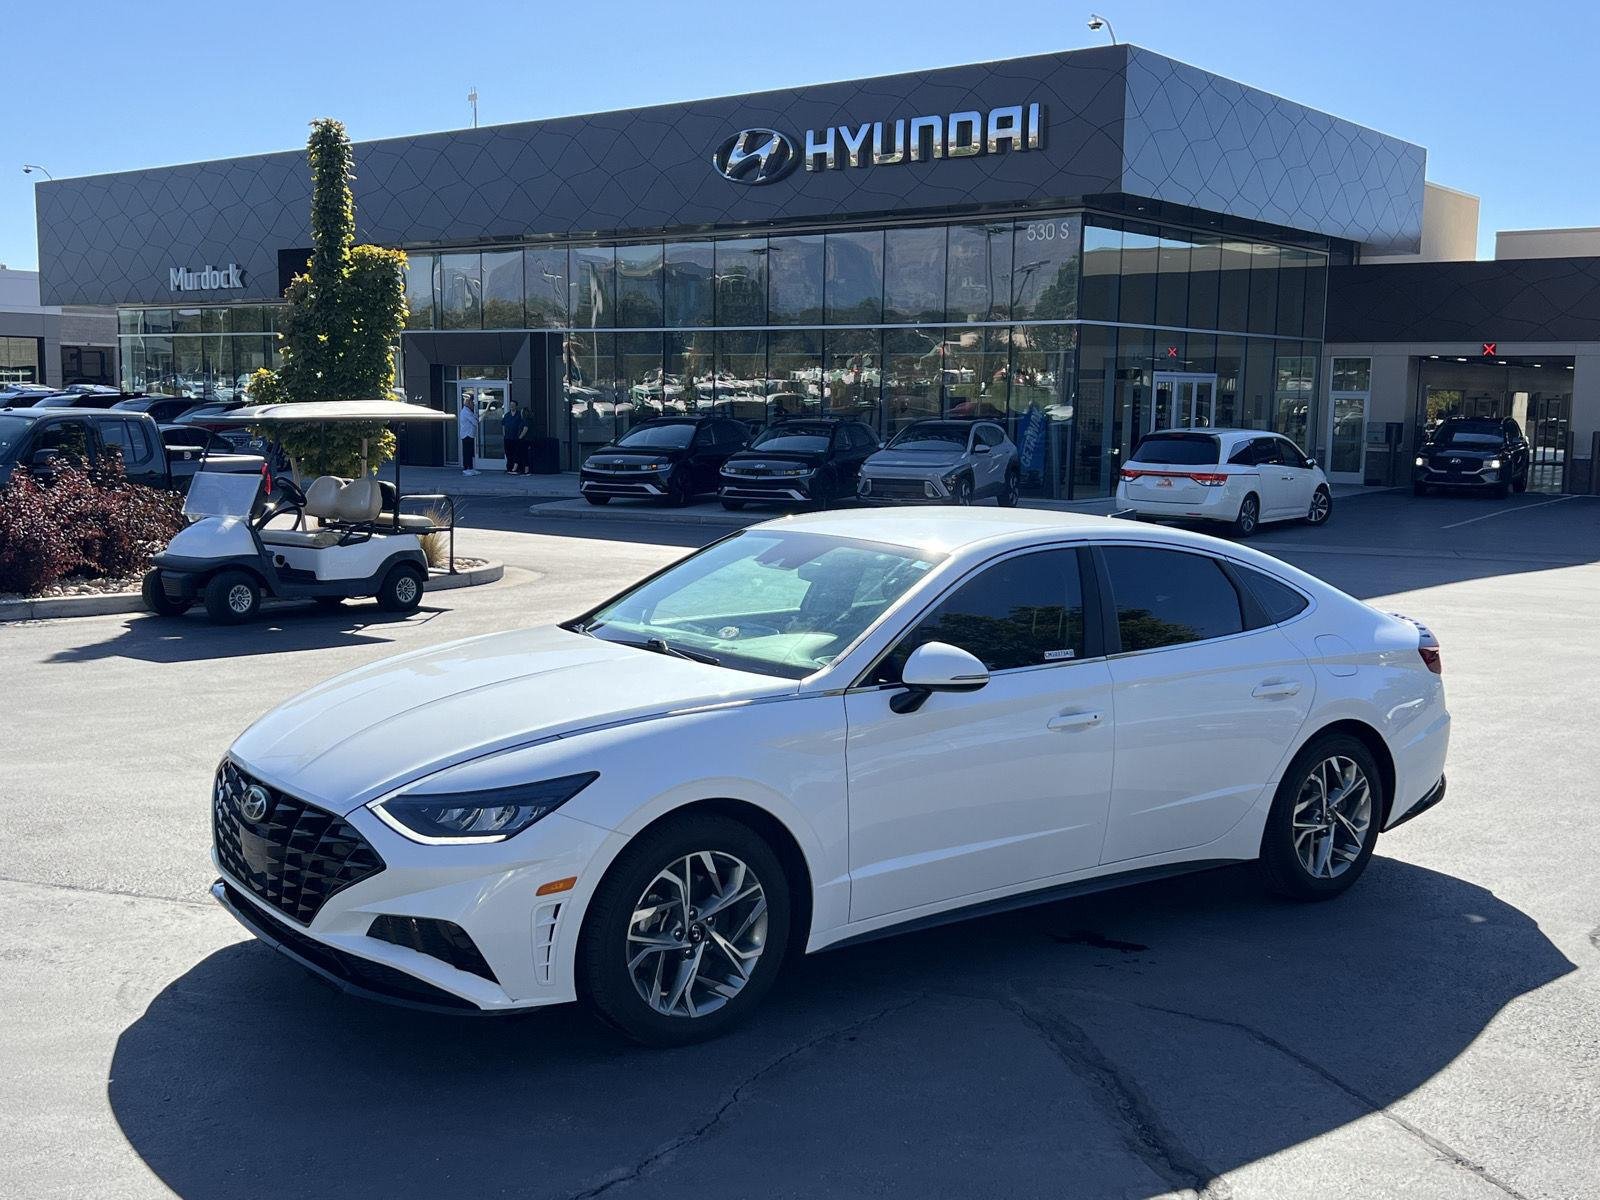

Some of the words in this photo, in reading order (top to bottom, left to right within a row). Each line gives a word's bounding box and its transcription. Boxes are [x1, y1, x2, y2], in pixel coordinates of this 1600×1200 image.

[806, 102, 1041, 172] HYUNDAI
[1027, 222, 1056, 241] 530
[1060, 222, 1069, 240] S
[169, 263, 244, 291] Murdock
